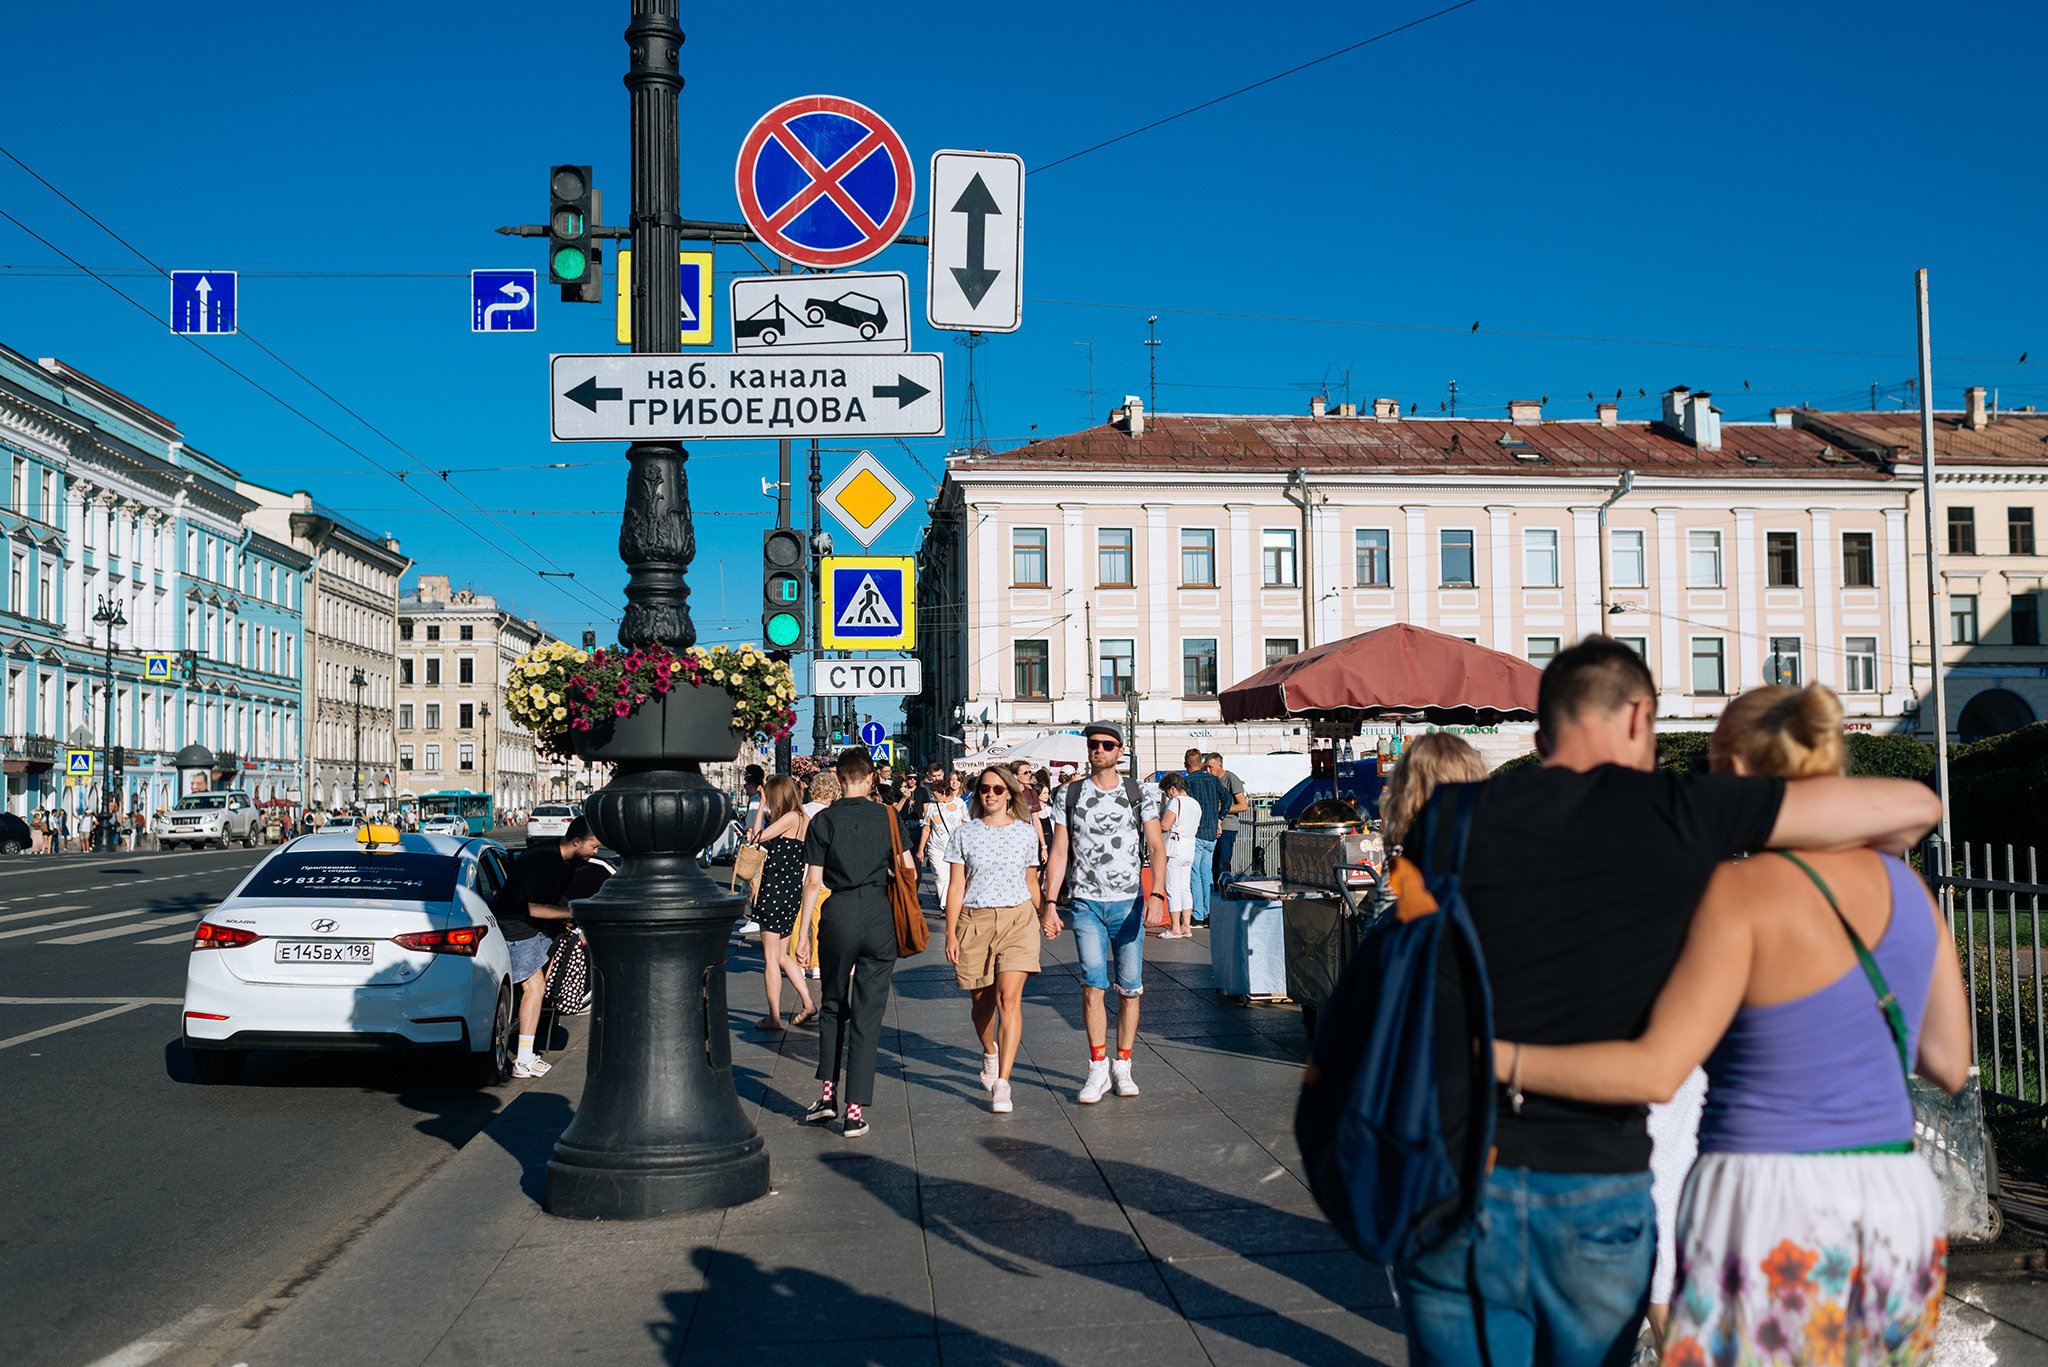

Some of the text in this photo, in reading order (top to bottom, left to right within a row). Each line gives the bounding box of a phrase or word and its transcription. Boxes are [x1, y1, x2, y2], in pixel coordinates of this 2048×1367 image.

[647, 362, 847, 389] наб. канала
[629, 397, 867, 428] ГРИБОЕДОВА
[829, 665, 906, 689] СТОП
[1389, 727, 1407, 735] LIE
[272, 876, 424, 887] +7 812 240-44-44
[346, 944, 370, 957] 198
